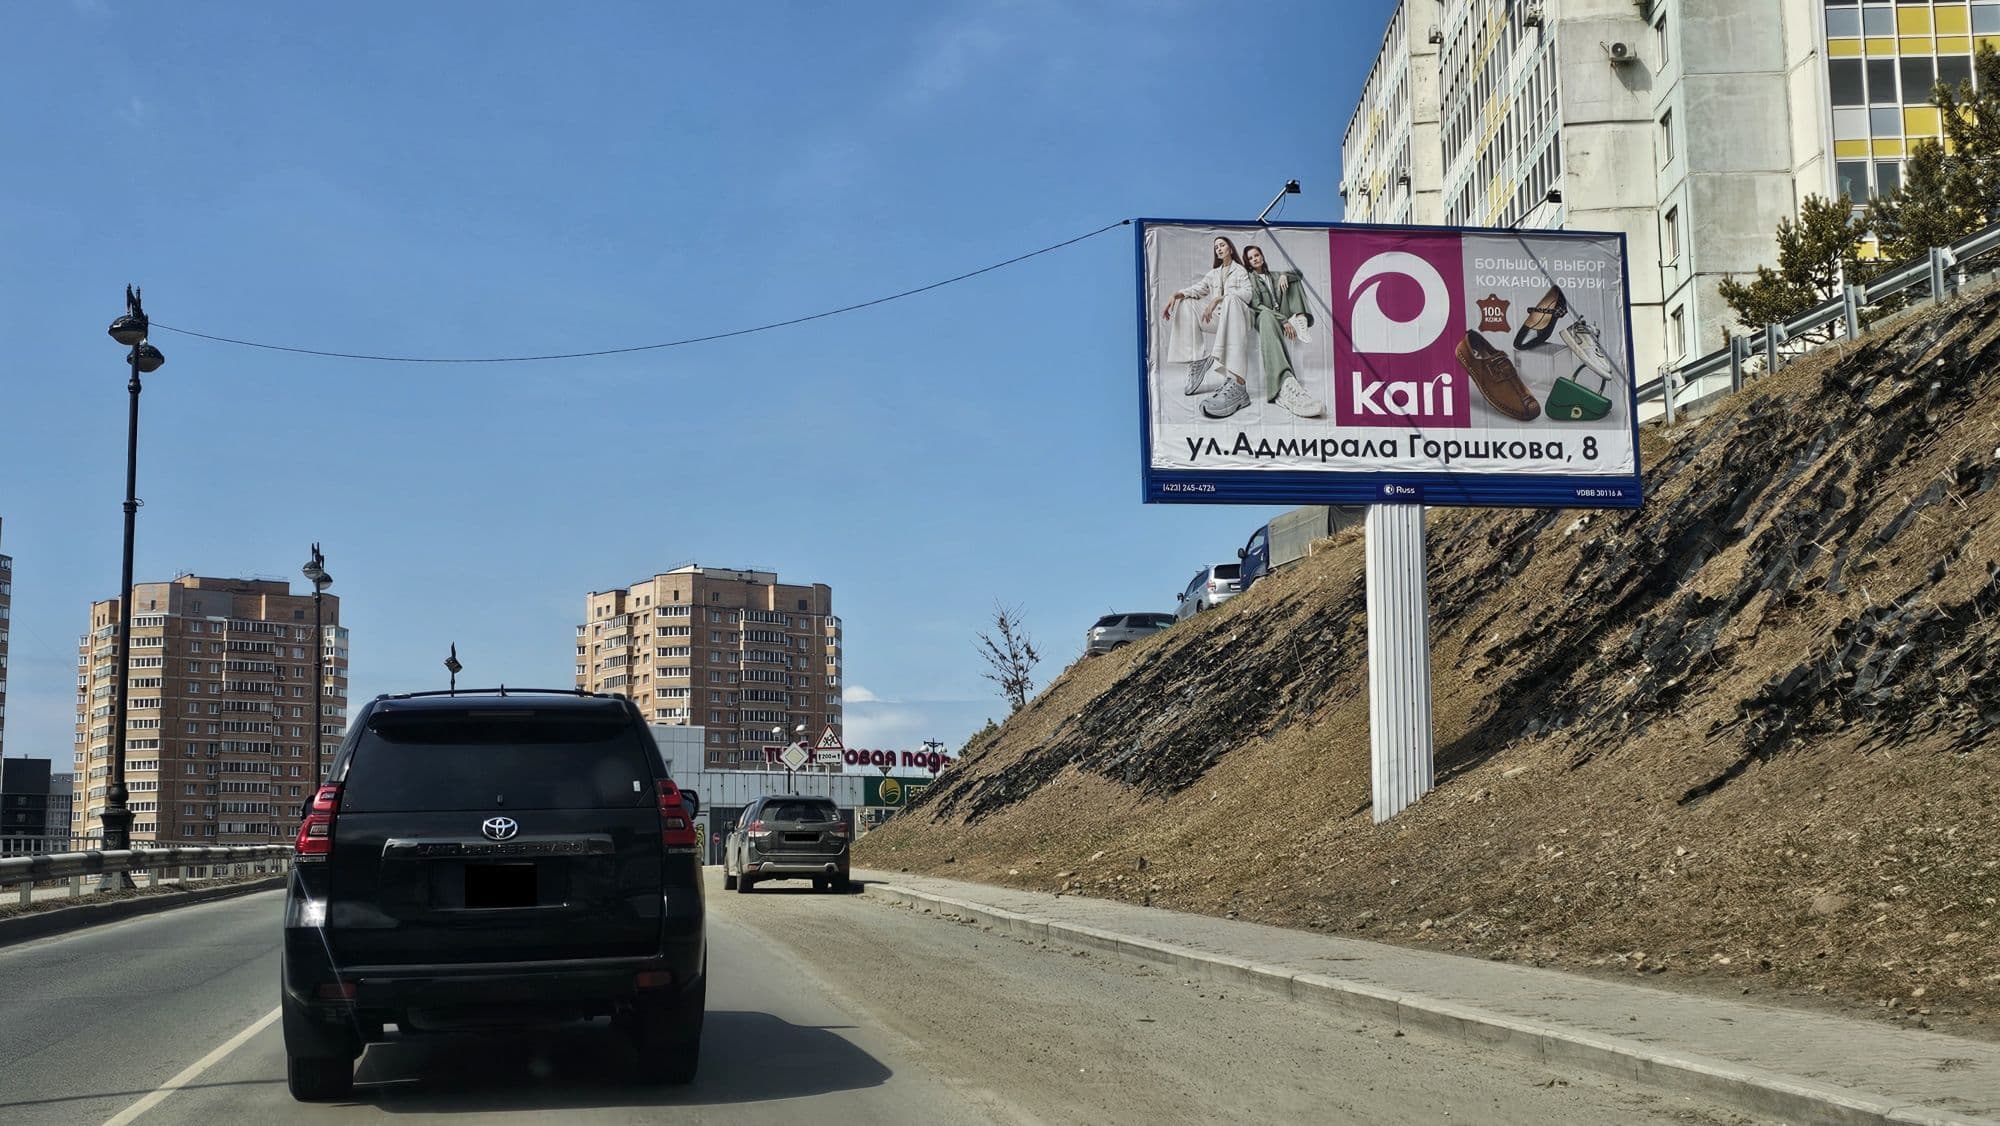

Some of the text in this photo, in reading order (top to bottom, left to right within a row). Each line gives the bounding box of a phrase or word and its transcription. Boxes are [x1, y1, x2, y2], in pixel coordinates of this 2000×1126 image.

[1475, 257, 1606, 272] БОЛЬШОЙ ВЫБОР
[1476, 274, 1606, 289] КОЖАНОЙ ОБУВИ
[1352, 371, 1454, 416] kari
[1186, 432, 1599, 464] ул.Адмирала Горшкова, 8
[1396, 486, 1415, 494] Russ
